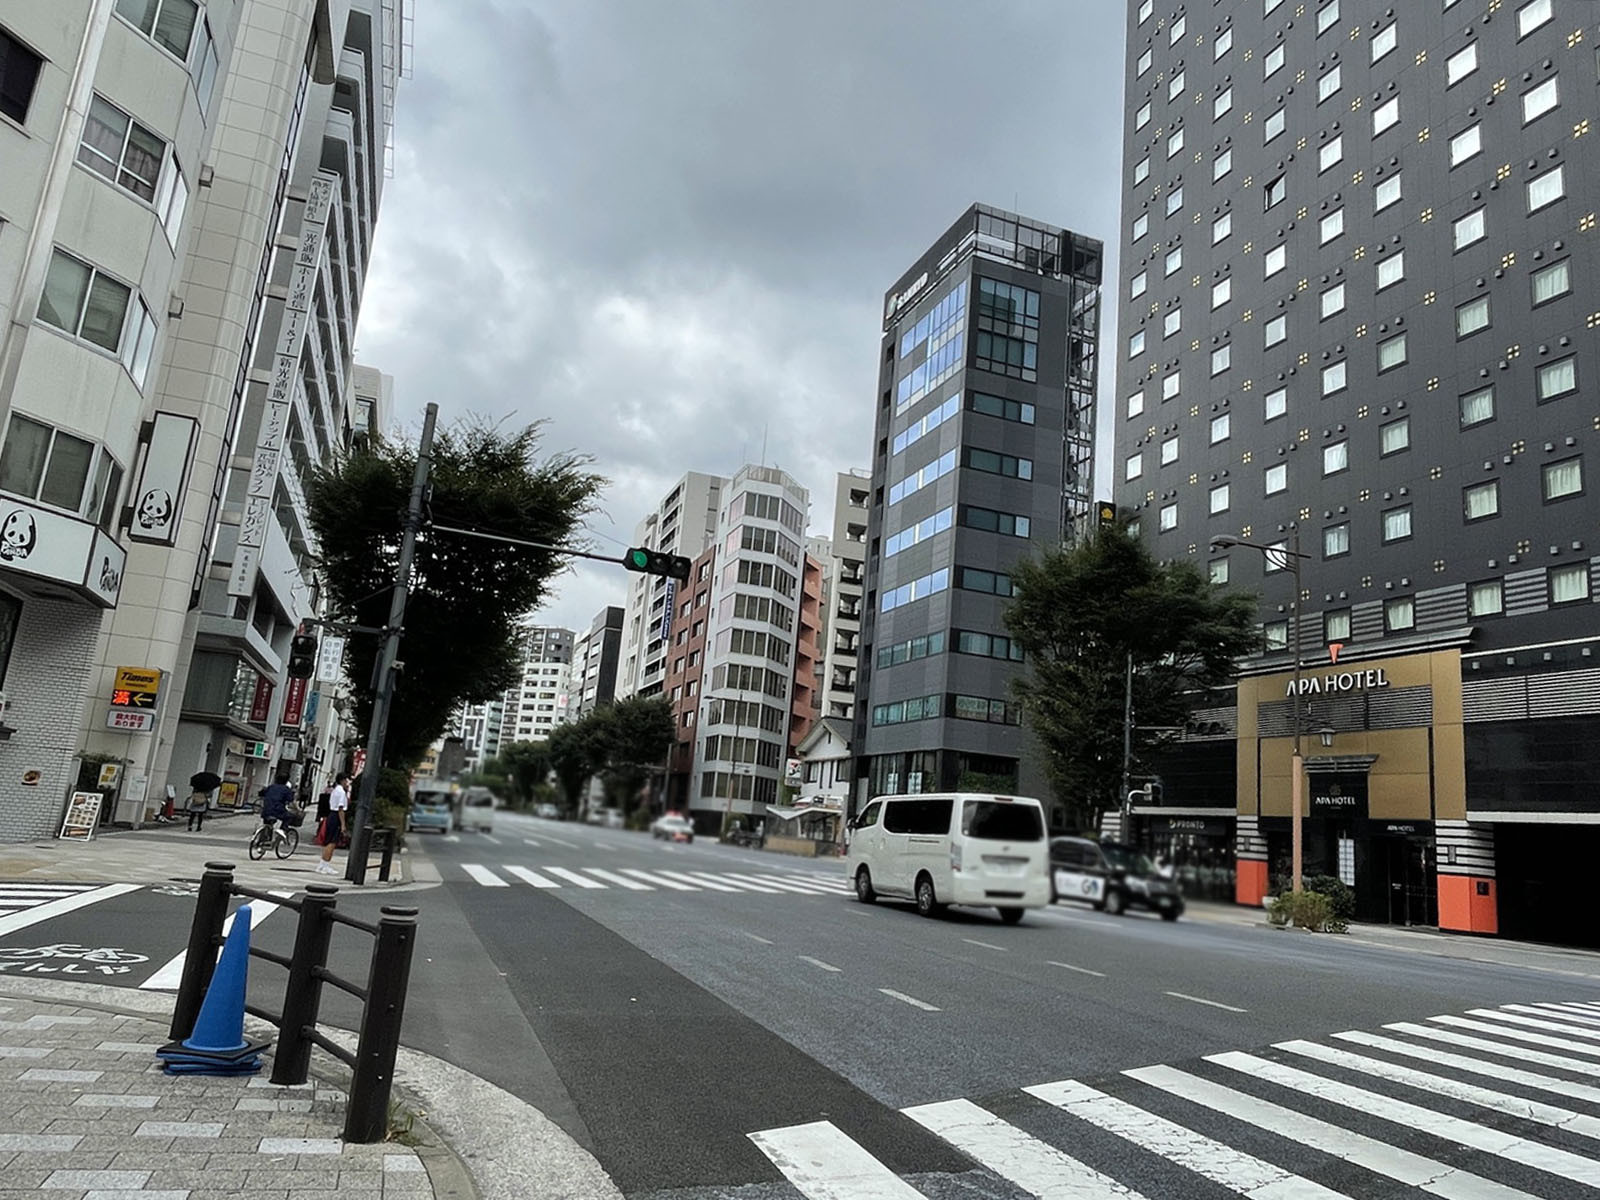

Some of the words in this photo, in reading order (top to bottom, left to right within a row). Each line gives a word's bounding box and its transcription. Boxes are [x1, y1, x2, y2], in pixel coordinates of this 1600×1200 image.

[121, 671, 154, 683] Times
[1286, 677, 1321, 697] APA
[1325, 668, 1388, 692] HOTEL
[1315, 797, 1331, 805] APA
[1332, 796, 1356, 805] HOTEL
